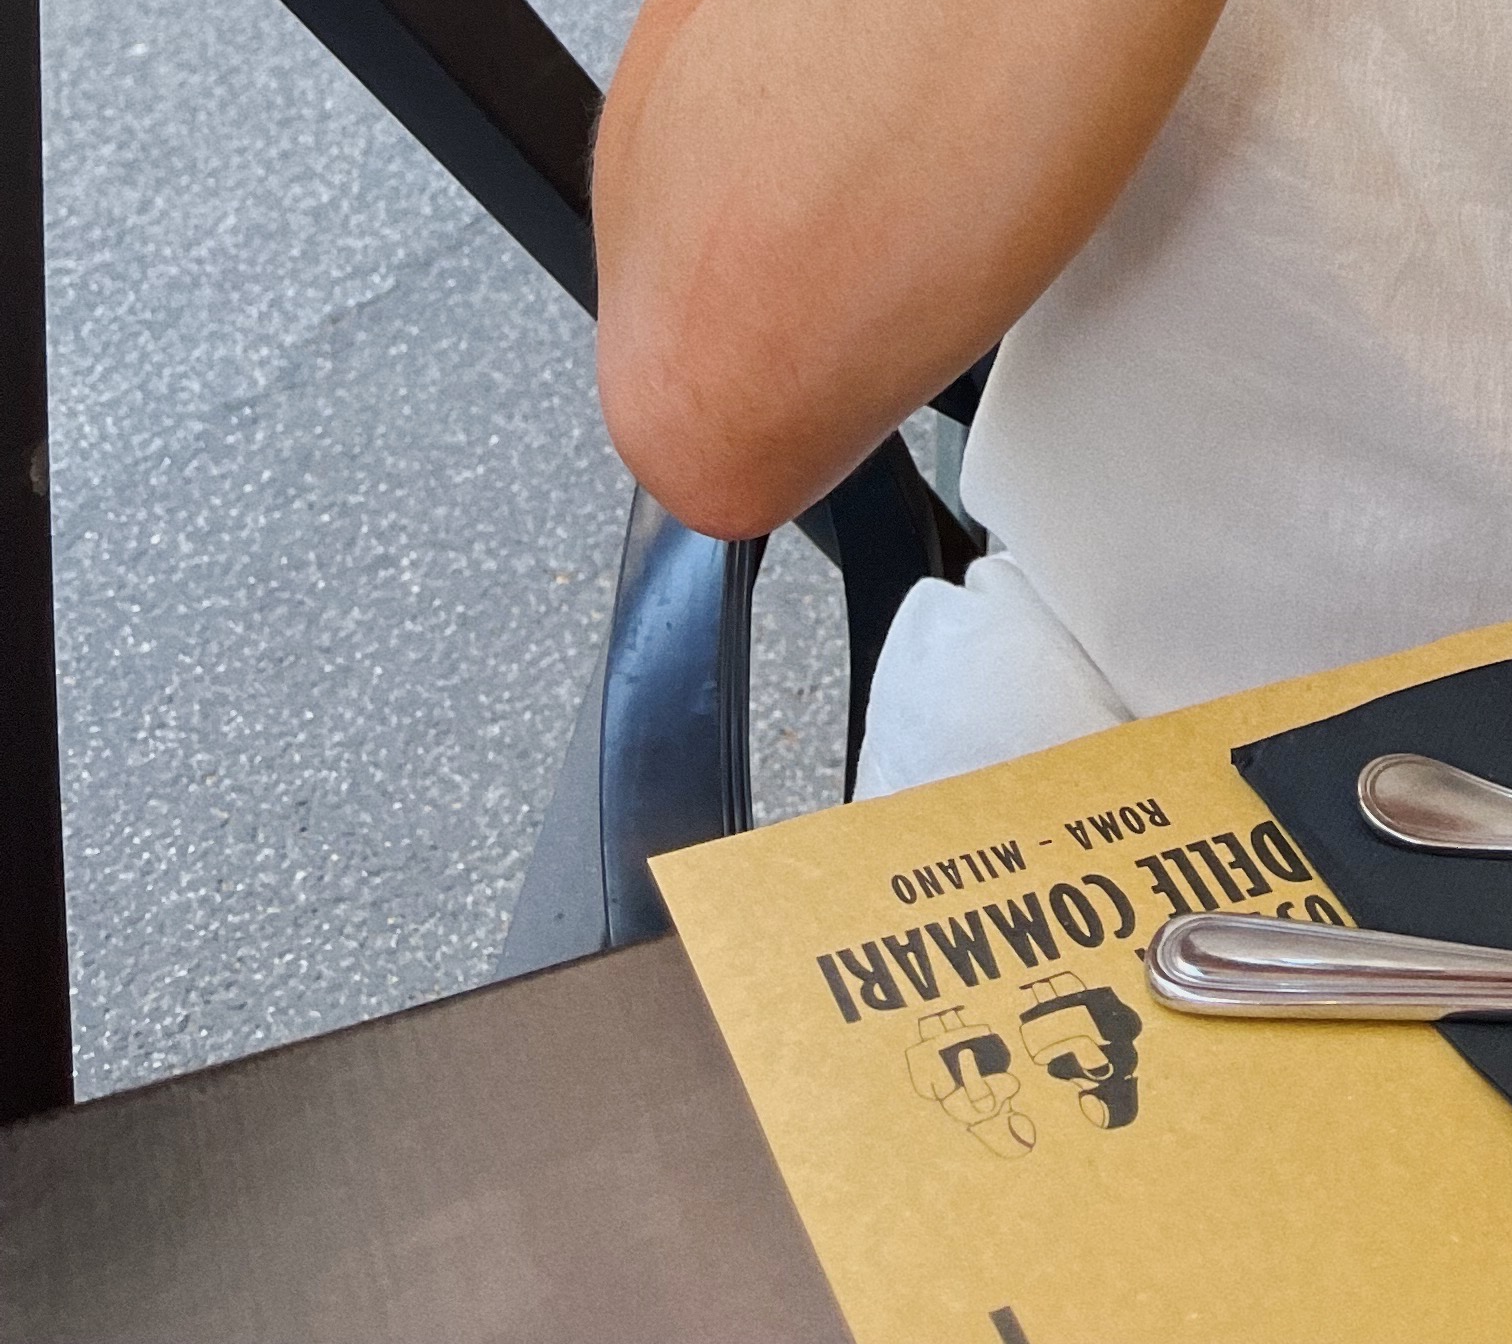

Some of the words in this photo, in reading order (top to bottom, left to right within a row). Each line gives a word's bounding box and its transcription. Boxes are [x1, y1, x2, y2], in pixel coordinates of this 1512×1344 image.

[1064, 798, 1171, 850] ROMA
[890, 840, 1026, 905] MILANO
[1134, 818, 1313, 919] DELLE
[815, 873, 1136, 1024] COMMARI
